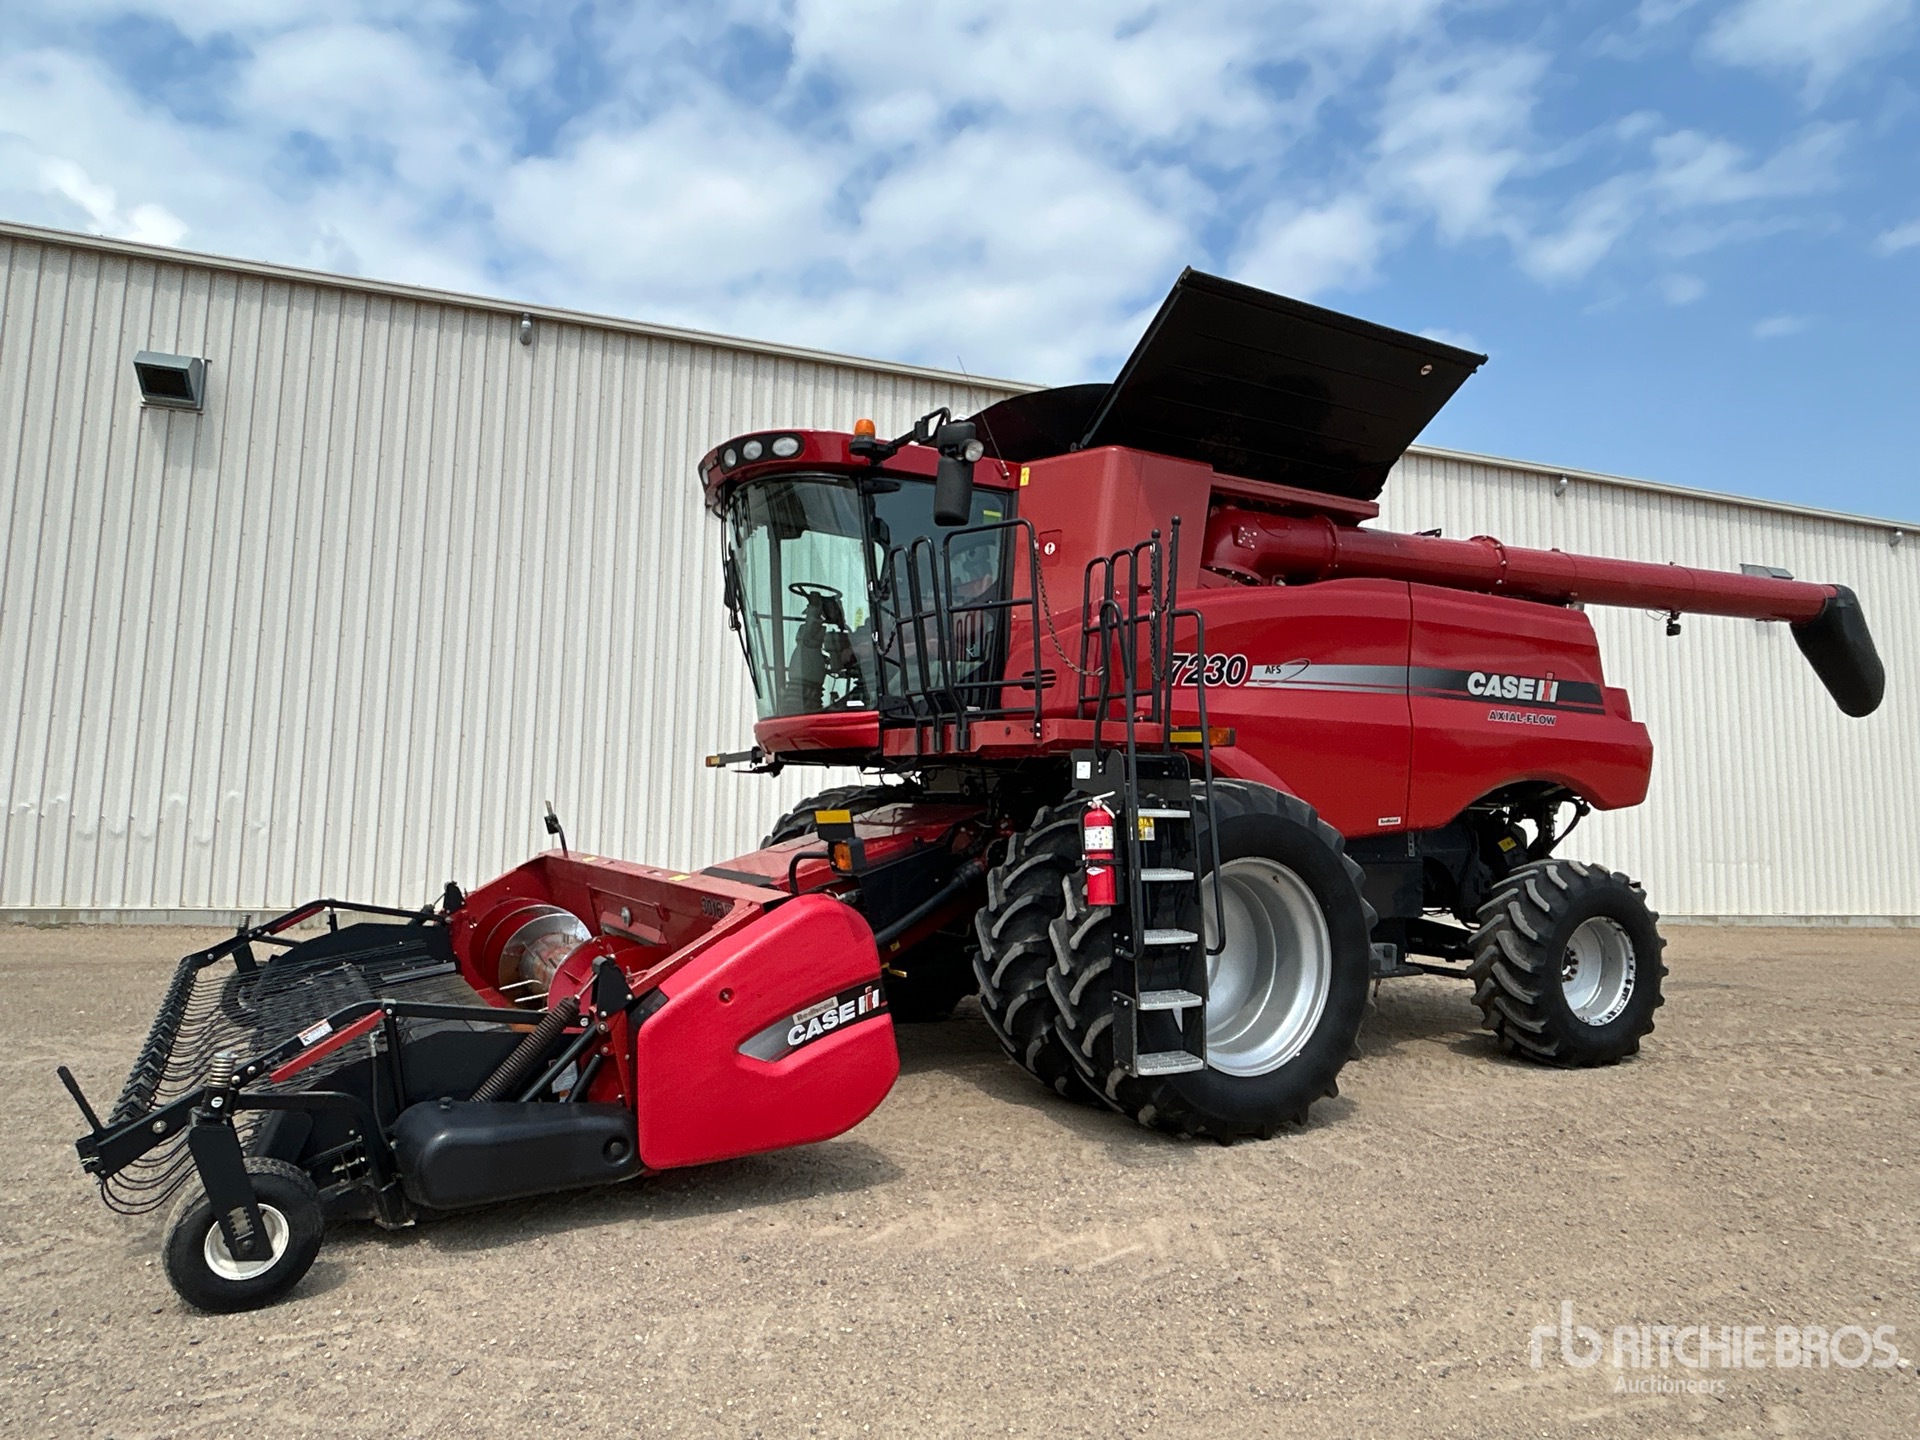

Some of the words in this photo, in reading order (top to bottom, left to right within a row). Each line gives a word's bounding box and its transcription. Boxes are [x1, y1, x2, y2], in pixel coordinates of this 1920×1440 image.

[1172, 653, 1248, 687] 7230
[1265, 665, 1281, 674] AFS
[1488, 710, 1556, 726] AXIAL-FLOW
